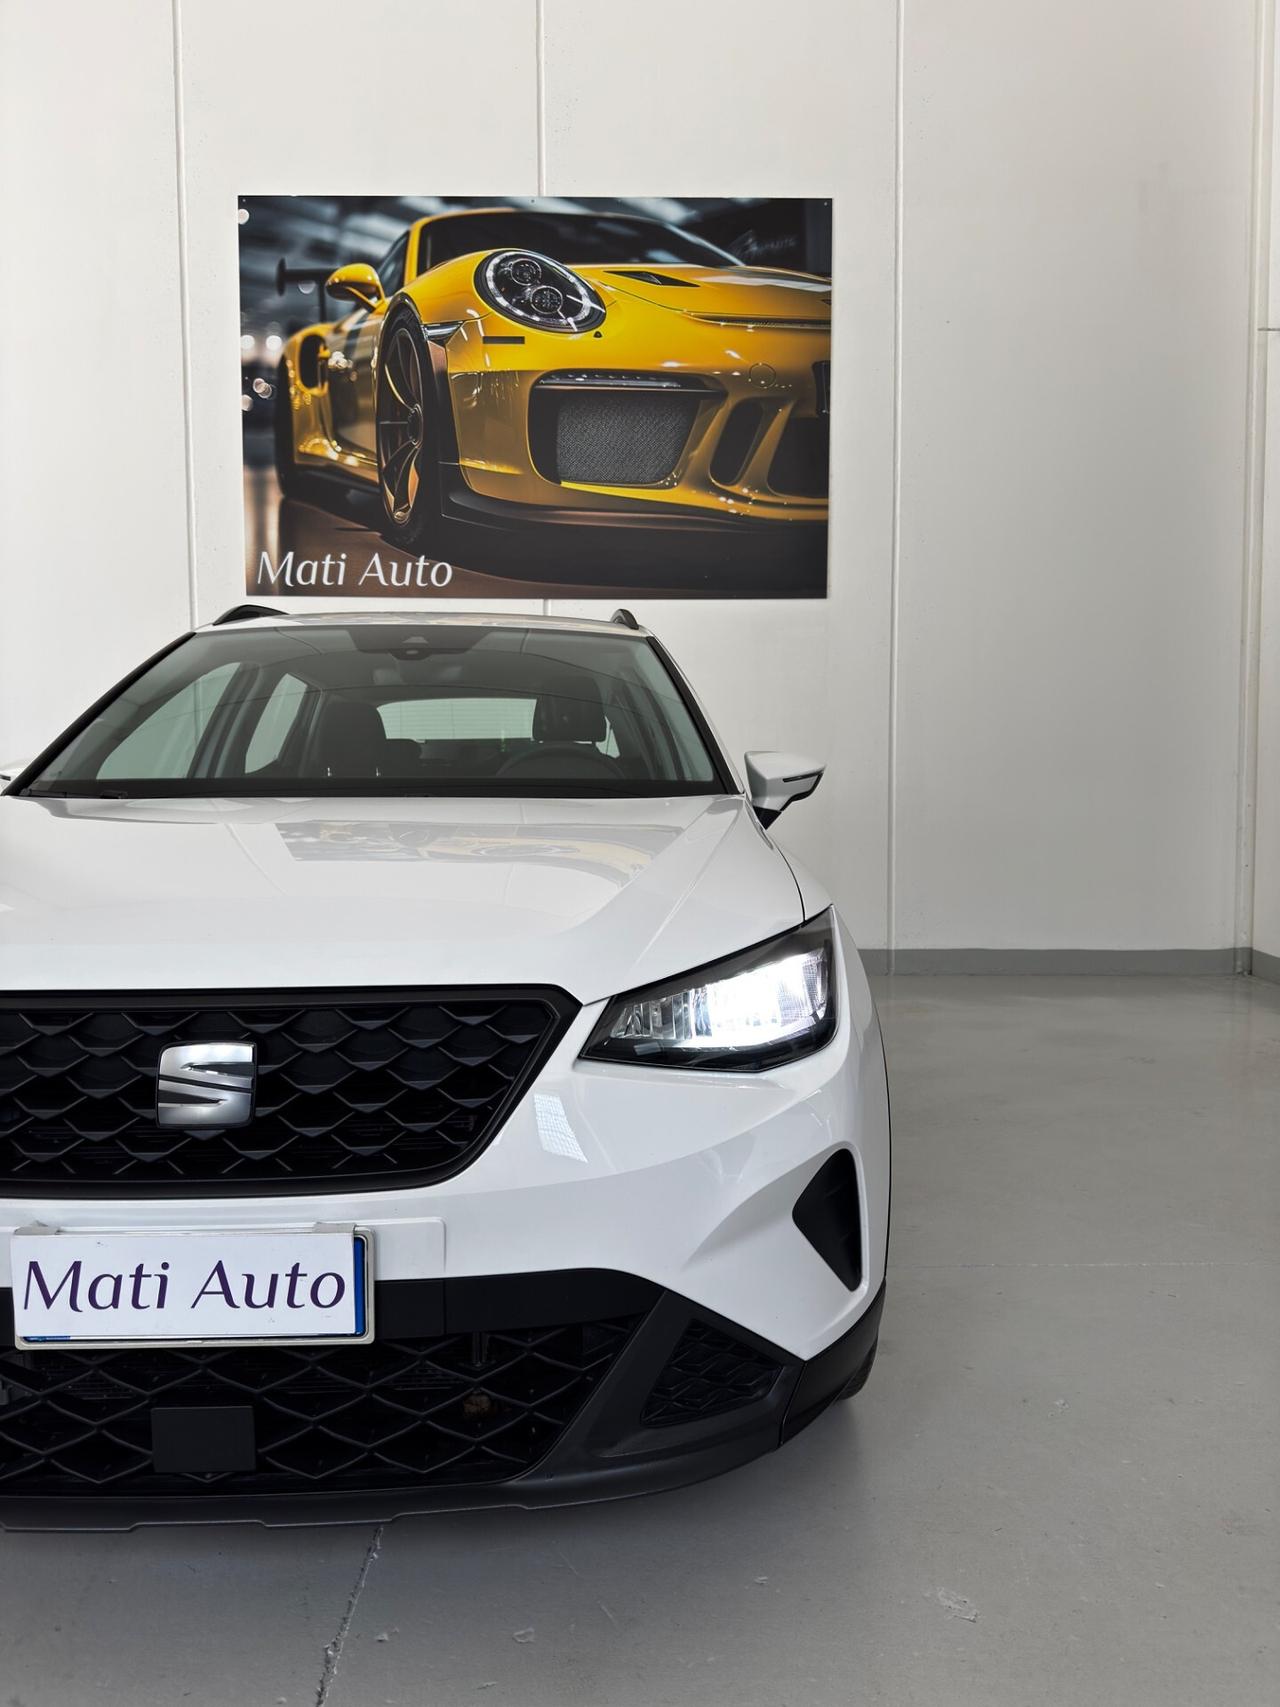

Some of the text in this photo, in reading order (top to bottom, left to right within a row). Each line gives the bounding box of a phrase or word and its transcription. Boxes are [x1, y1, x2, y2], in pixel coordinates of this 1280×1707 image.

[257, 551, 453, 588] Mati Auto
[24, 1260, 346, 1313] Mati Auto
